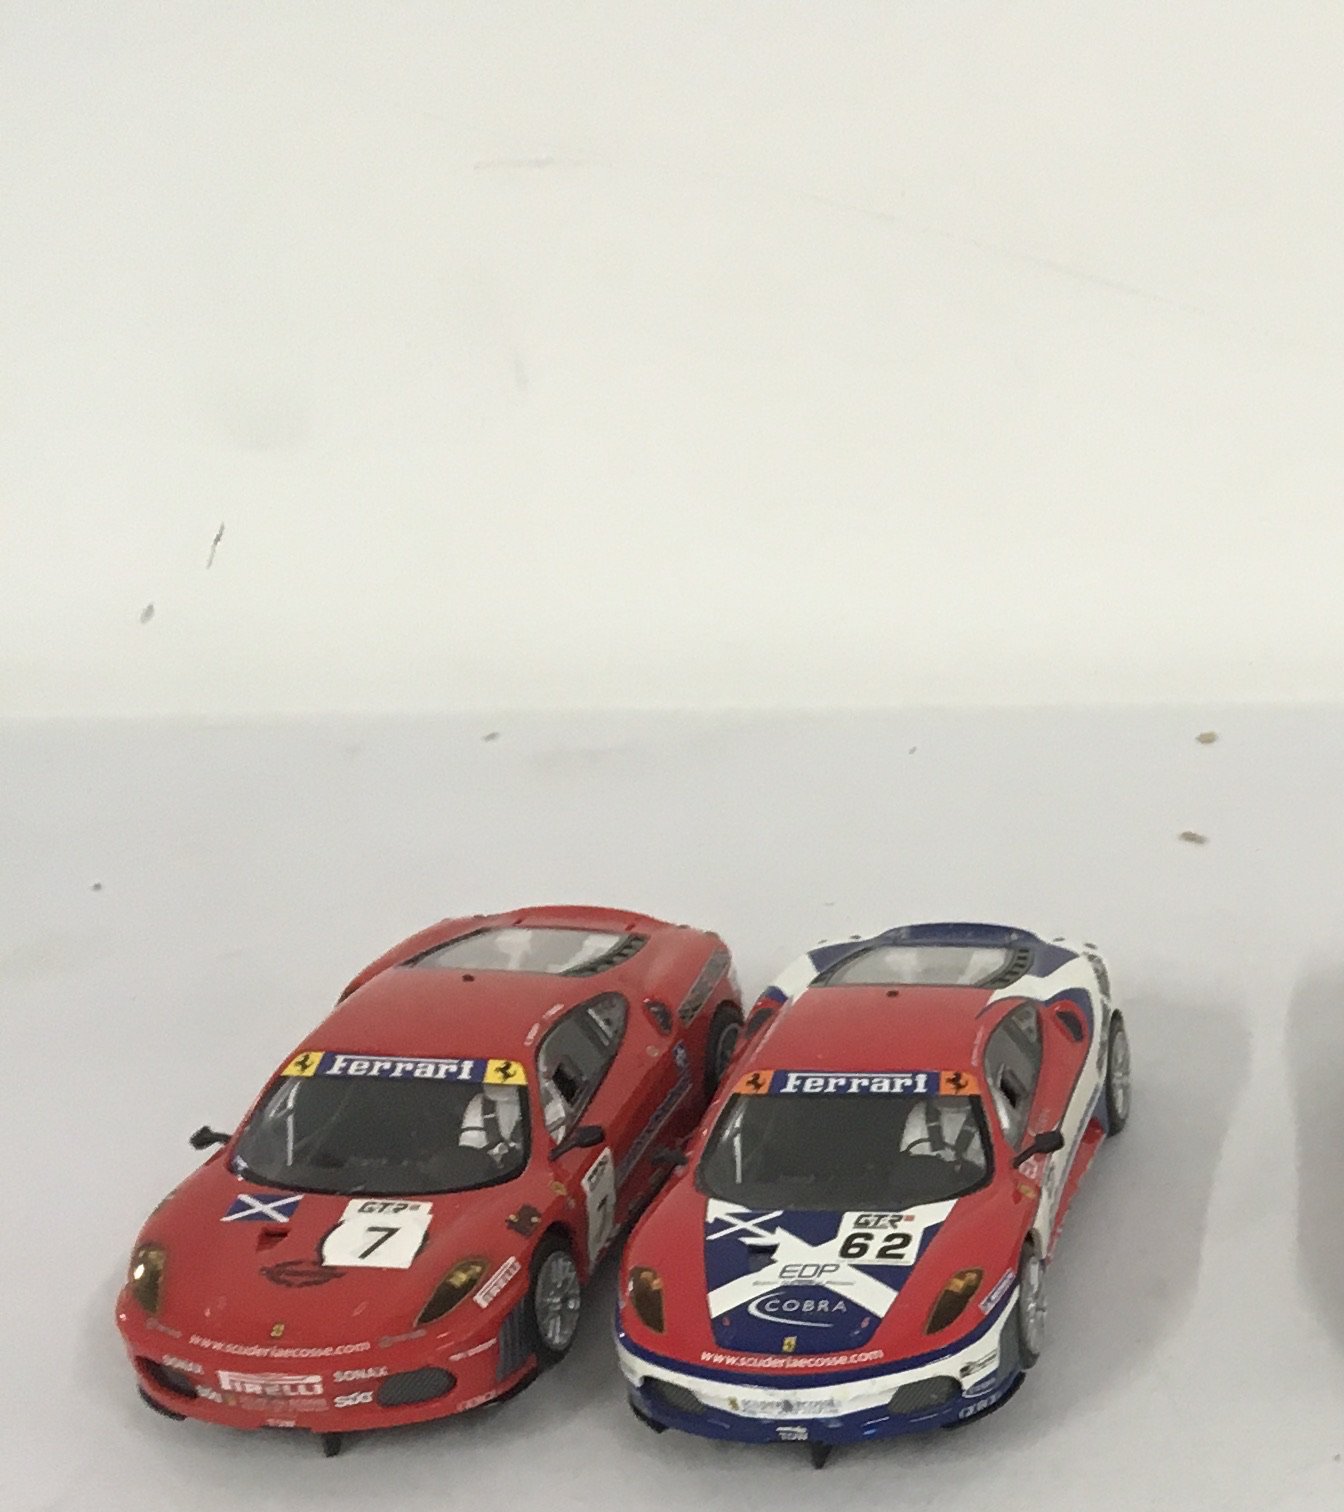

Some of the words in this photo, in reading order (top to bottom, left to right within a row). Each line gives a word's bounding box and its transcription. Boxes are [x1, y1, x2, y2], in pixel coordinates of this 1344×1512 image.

[323, 1054, 475, 1081] Ferrari
[779, 1072, 928, 1093] Ferrari
[358, 1226, 402, 1260] 7
[839, 1232, 913, 1260] 62
[764, 1299, 848, 1313] COBRA
[701, 1349, 885, 1368] www.scuderiaecosse.com
[215, 1370, 324, 1396] PIRELLI
